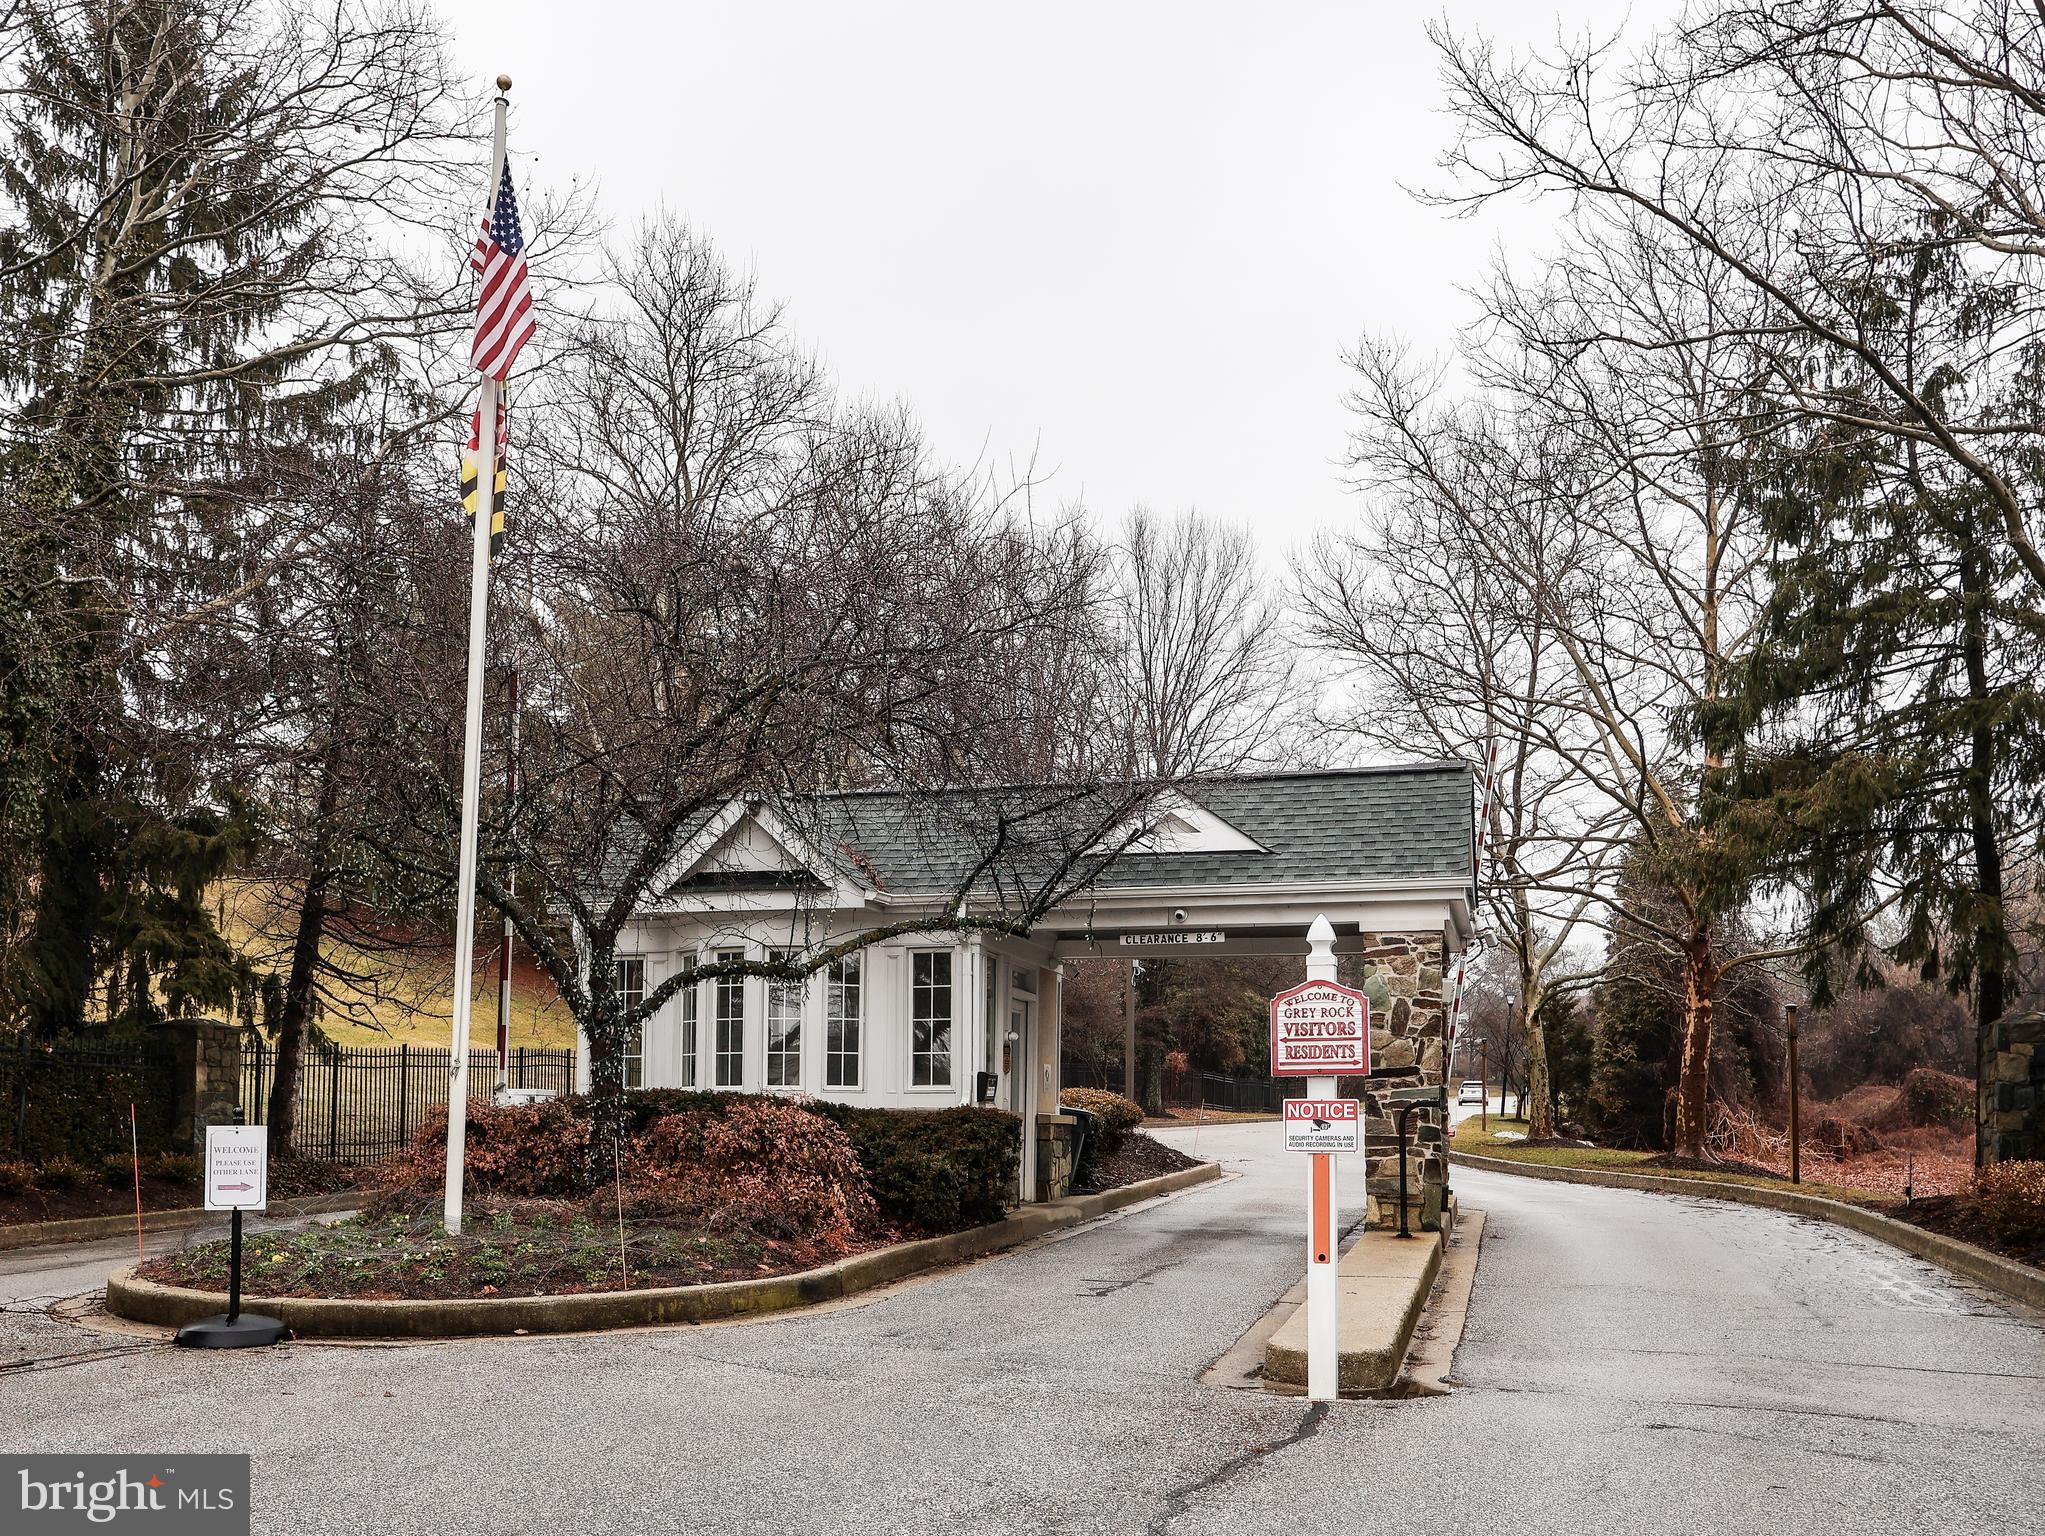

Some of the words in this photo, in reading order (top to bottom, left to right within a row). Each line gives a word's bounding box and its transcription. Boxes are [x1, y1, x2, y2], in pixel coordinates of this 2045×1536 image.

[1125, 934, 1189, 945] CLEARANCE
[1284, 992, 1339, 1007] WELCOME
[1340, 995, 1355, 1007] TO
[1284, 1007, 1317, 1018] GREY
[1321, 1006, 1354, 1018] ROCK
[1283, 1021, 1356, 1037] VISITORS
[1284, 1044, 1356, 1060] RESIDENTS
[1287, 1103, 1355, 1118] NOTICE
[213, 1146, 260, 1154] WELCOME
[239, 1168, 260, 1176] LANE
